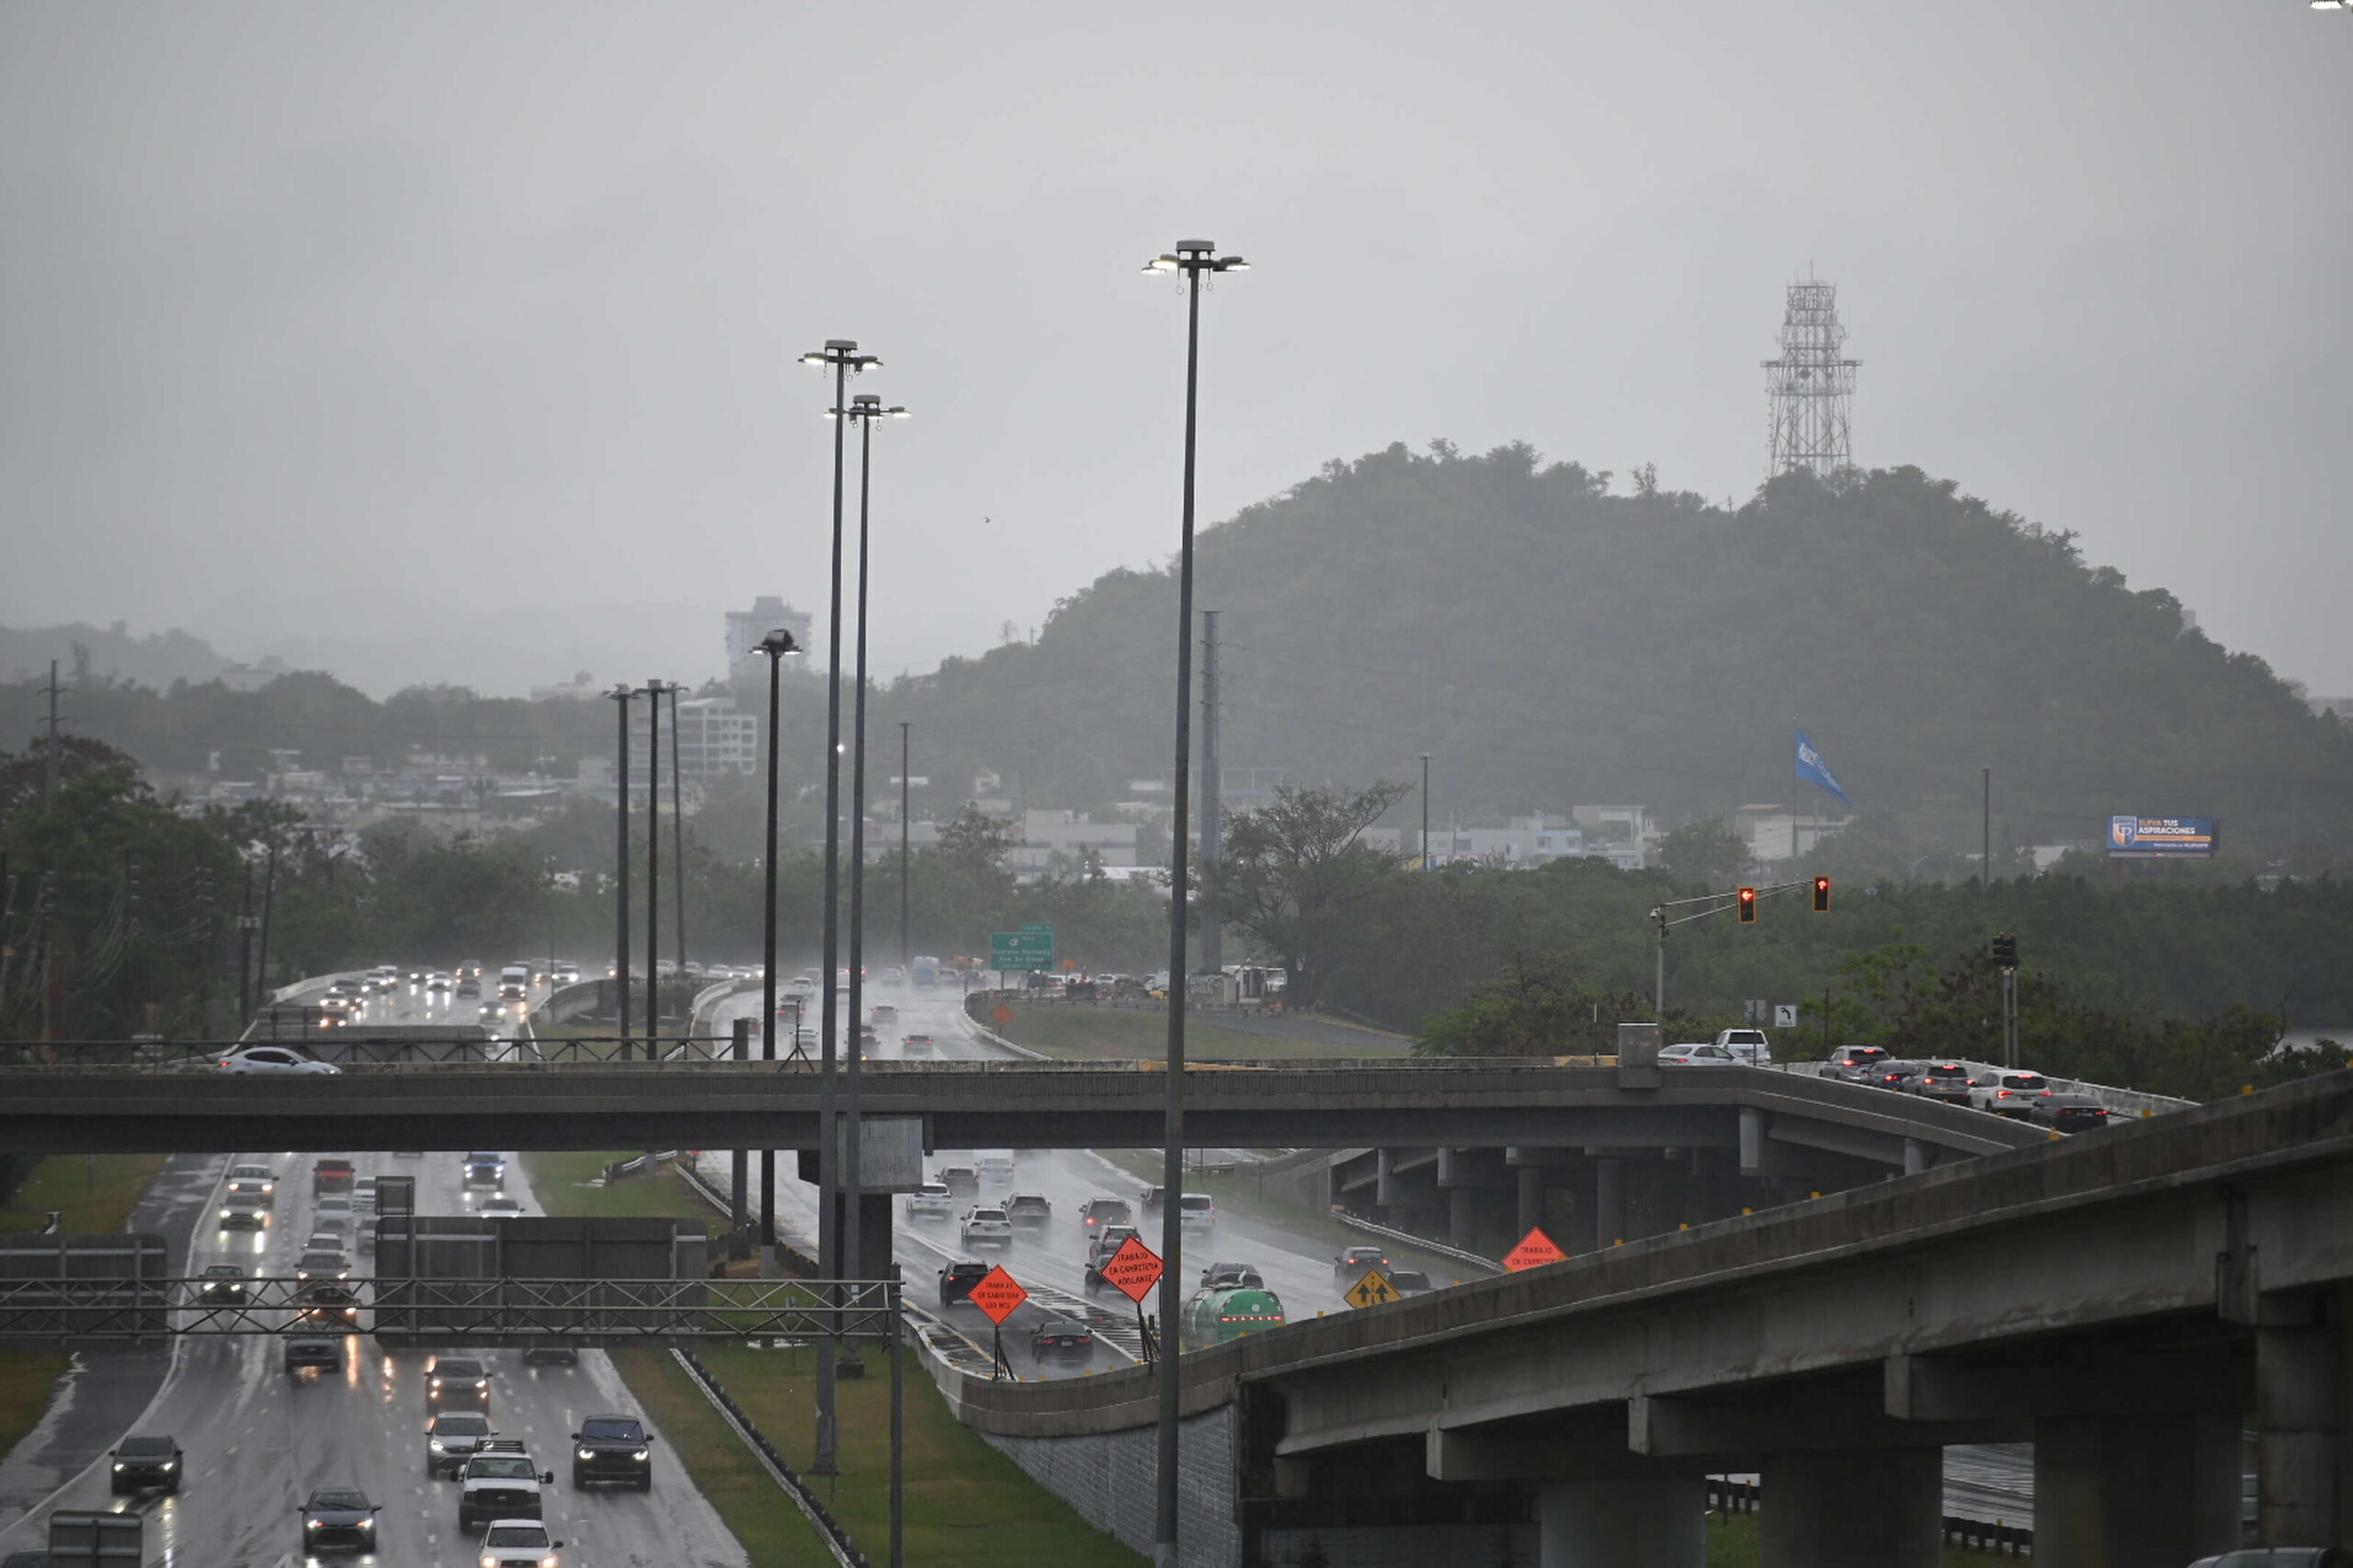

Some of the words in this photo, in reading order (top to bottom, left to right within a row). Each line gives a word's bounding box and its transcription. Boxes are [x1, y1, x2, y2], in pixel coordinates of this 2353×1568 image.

[2138, 826, 2196, 835] ASPIRACIONES
[1117, 1252, 1148, 1262] TRABAJO
[1109, 1267, 1119, 1275] EN
[1120, 1262, 1158, 1273] CARRETERA
[1118, 1274, 1153, 1285] ADELANTE
